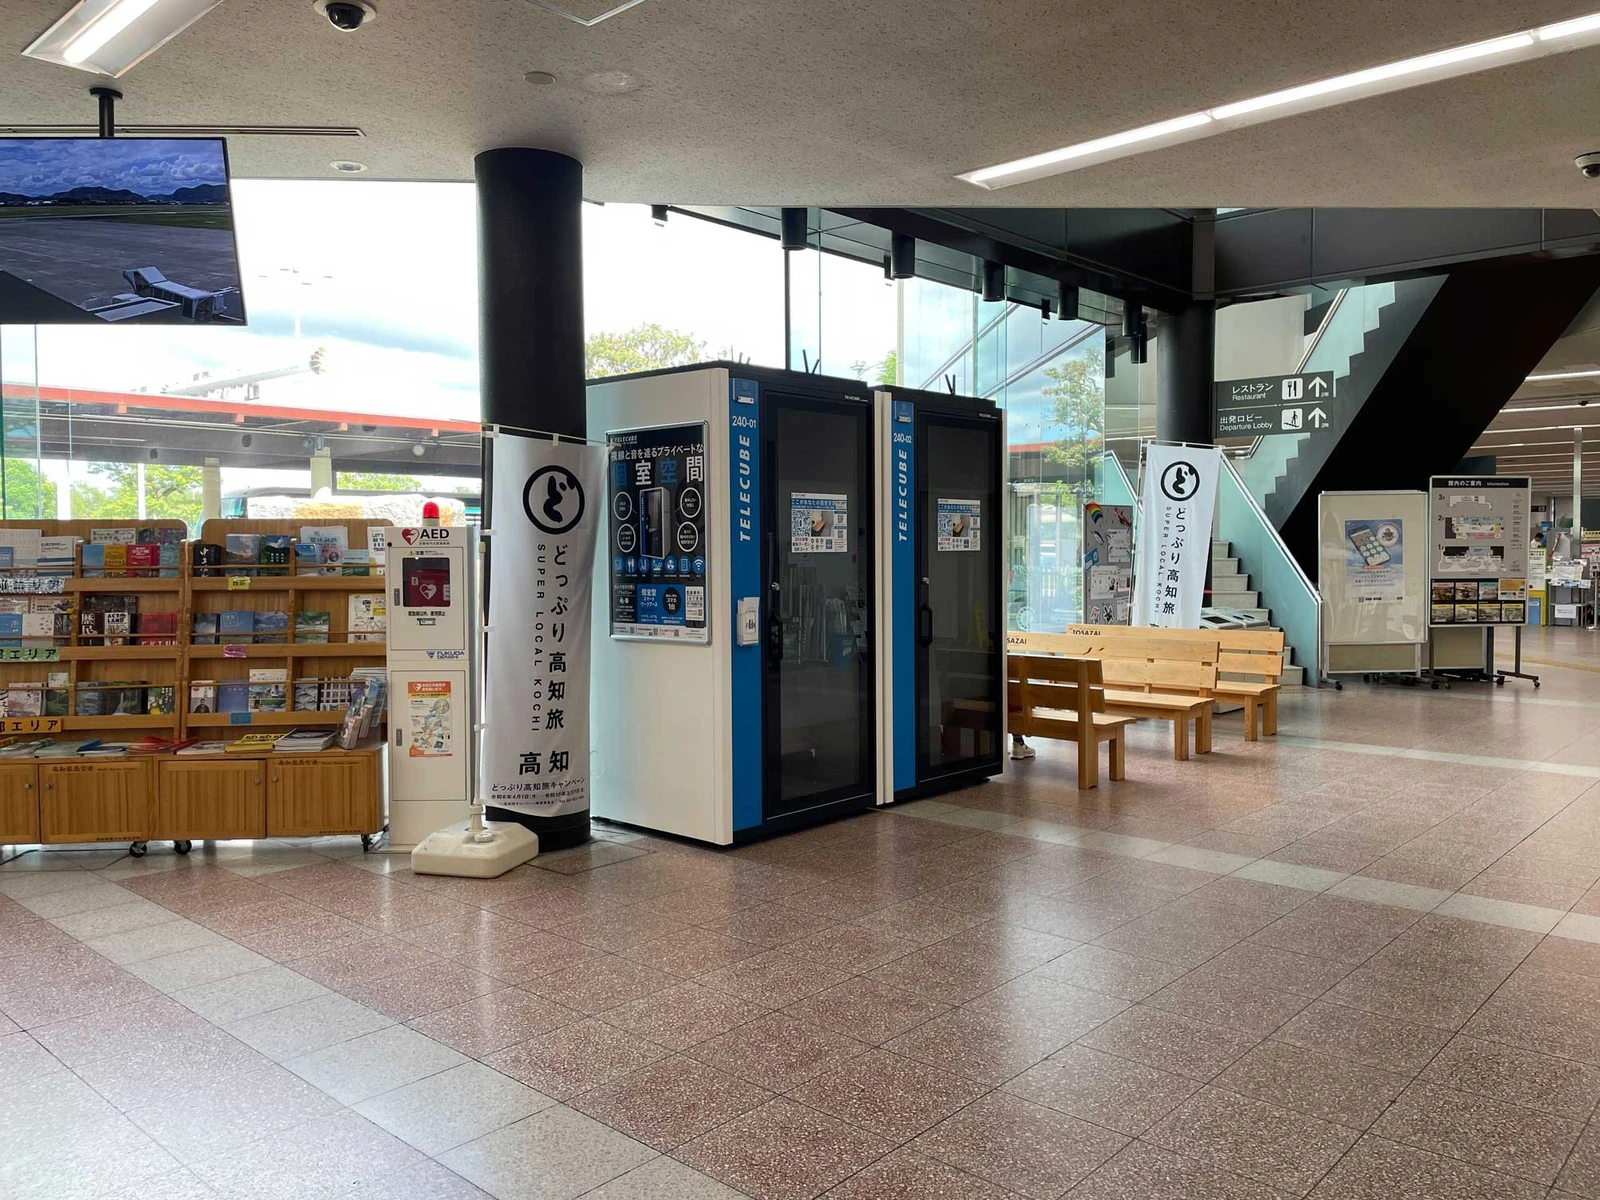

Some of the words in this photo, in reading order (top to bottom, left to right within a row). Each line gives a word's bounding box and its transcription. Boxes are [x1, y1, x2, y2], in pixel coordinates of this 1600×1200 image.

[1232, 383, 1274, 394] レストラン
[1232, 392, 1266, 401] Restaurant
[732, 416, 756, 428] 240-01
[1220, 413, 1262, 424] 出発ロビー
[1220, 423, 1252, 432] Departure
[1253, 422, 1273, 430] Lobby
[893, 433, 912, 443] 240-02
[739, 434, 751, 541] TELECUBE
[898, 449, 907, 542] TELECUBE
[420, 528, 450, 539] AED
[1163, 507, 1172, 538] SUPER
[537, 544, 545, 599] SUPER
[1158, 545, 1167, 576] LOCAL
[1154, 582, 1162, 613] KOCHI
[534, 611, 544, 666] LOCAL
[545, 544, 568, 730] どっぷり高知旅
[532, 679, 542, 731] KOCHI
[519, 750, 569, 775] 高知
[492, 777, 585, 792] どっぷり高知旅キャンペーン
